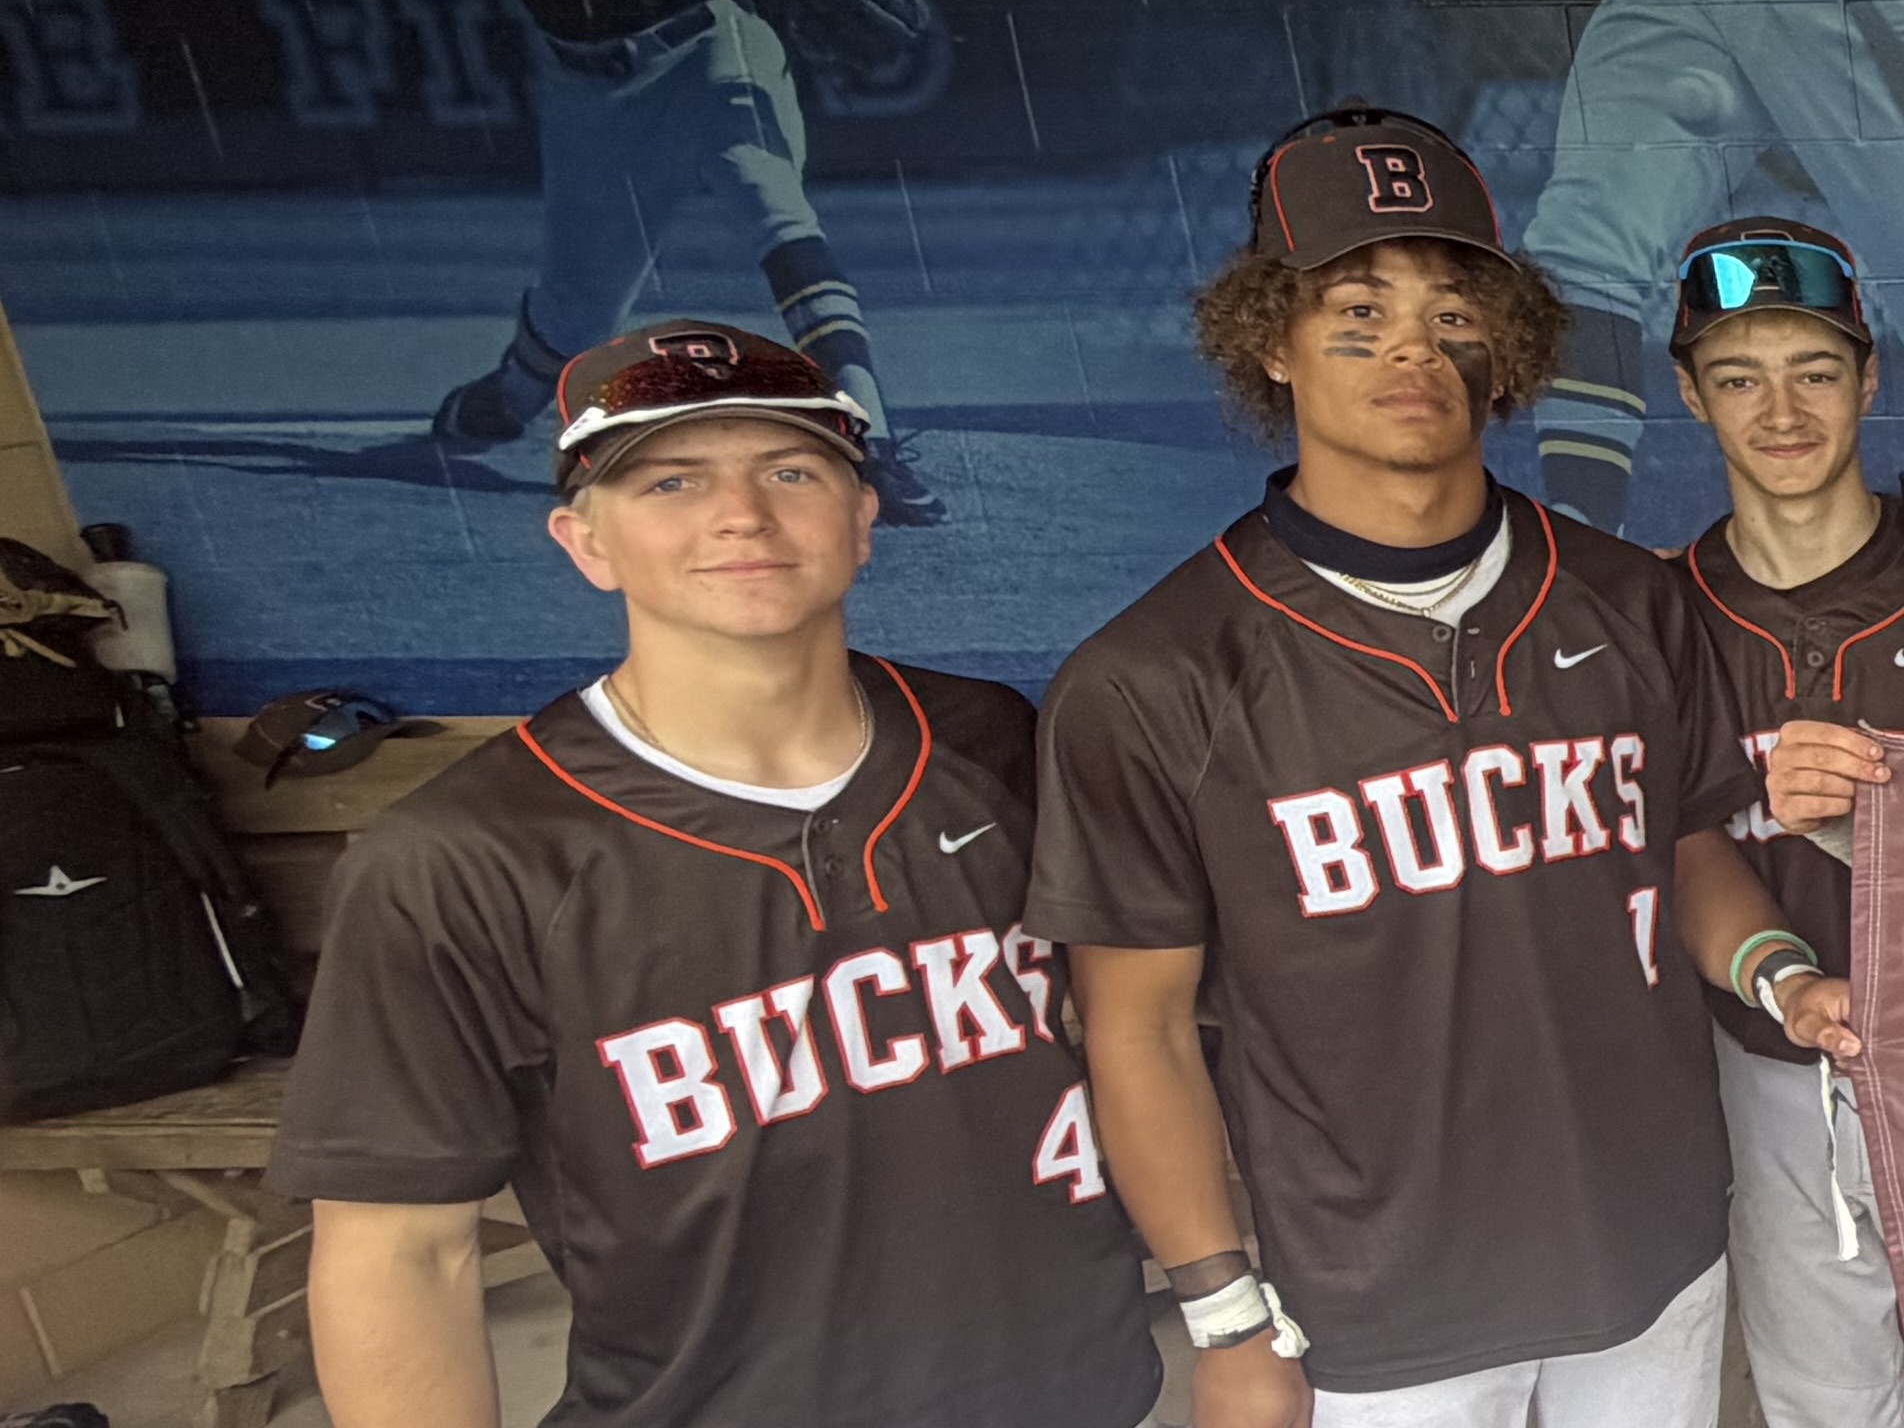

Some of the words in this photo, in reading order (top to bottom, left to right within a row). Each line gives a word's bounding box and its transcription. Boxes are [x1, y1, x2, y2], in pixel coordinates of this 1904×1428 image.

[1355, 144, 1435, 213] B
[1266, 732, 1648, 919] BUCKS
[594, 922, 1054, 1169] BUCKS
[1031, 1078, 1106, 1205] 4
